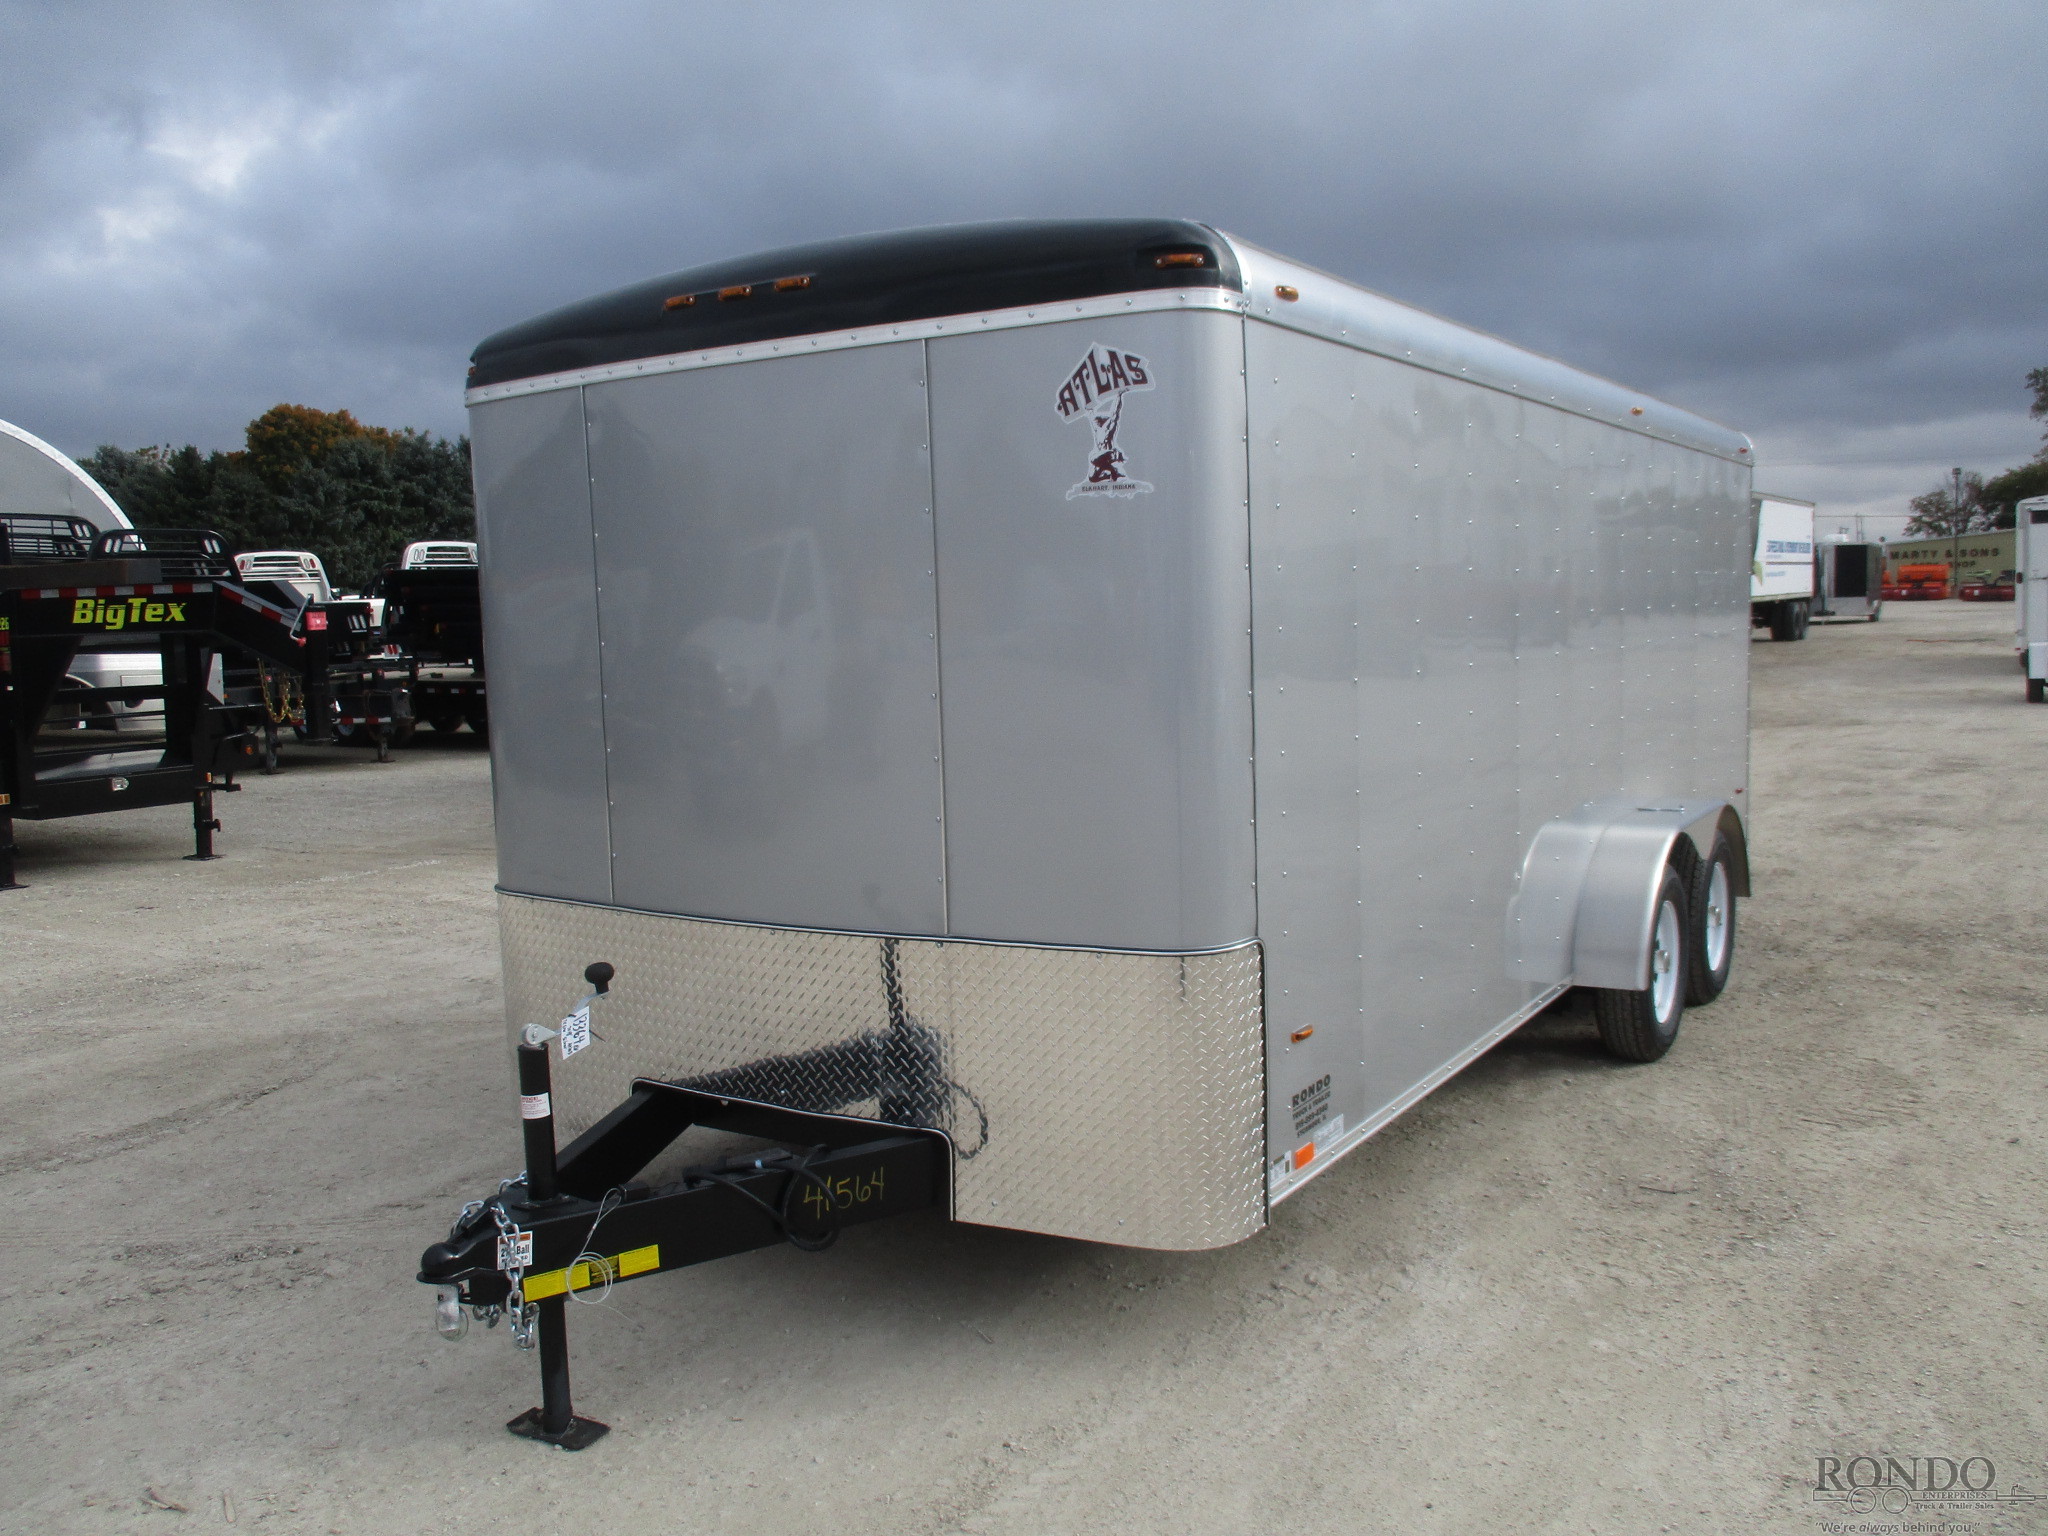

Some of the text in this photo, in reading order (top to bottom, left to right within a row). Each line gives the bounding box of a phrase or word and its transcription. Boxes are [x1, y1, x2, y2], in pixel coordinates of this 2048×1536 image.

[1057, 349, 1148, 416] ATLAS
[1890, 550, 1939, 559] MARTY
[1960, 548, 1999, 557] SONS
[73, 598, 187, 630] BigTex
[1292, 1074, 1331, 1107] RONDO
